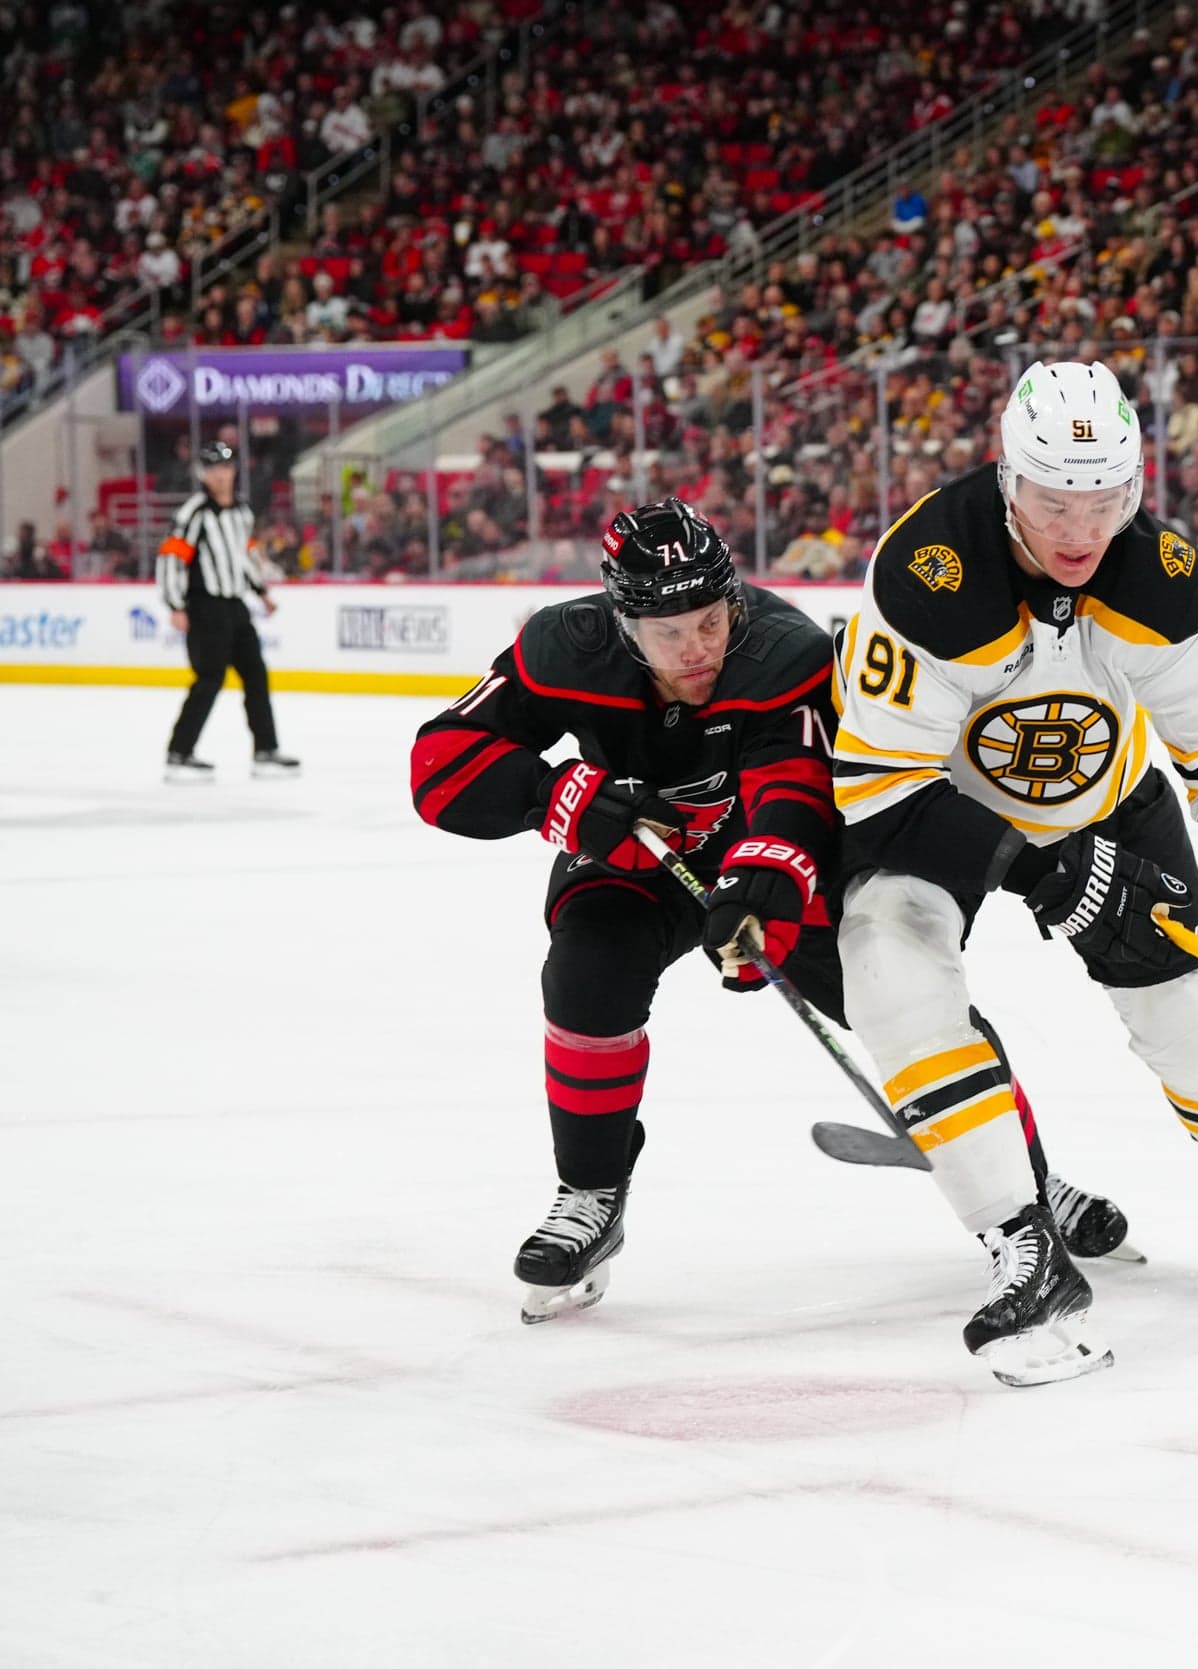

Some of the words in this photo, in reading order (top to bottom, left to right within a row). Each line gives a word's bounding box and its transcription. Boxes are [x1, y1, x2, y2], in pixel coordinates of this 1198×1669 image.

[656, 541, 689, 567] 71
[918, 547, 961, 589] BOSTON
[661, 576, 705, 596] CCM
[858, 630, 920, 712] 91
[671, 862, 706, 897] CCM
[1048, 835, 1117, 938] WARRIOR
[1117, 886, 1129, 917] COVERT
